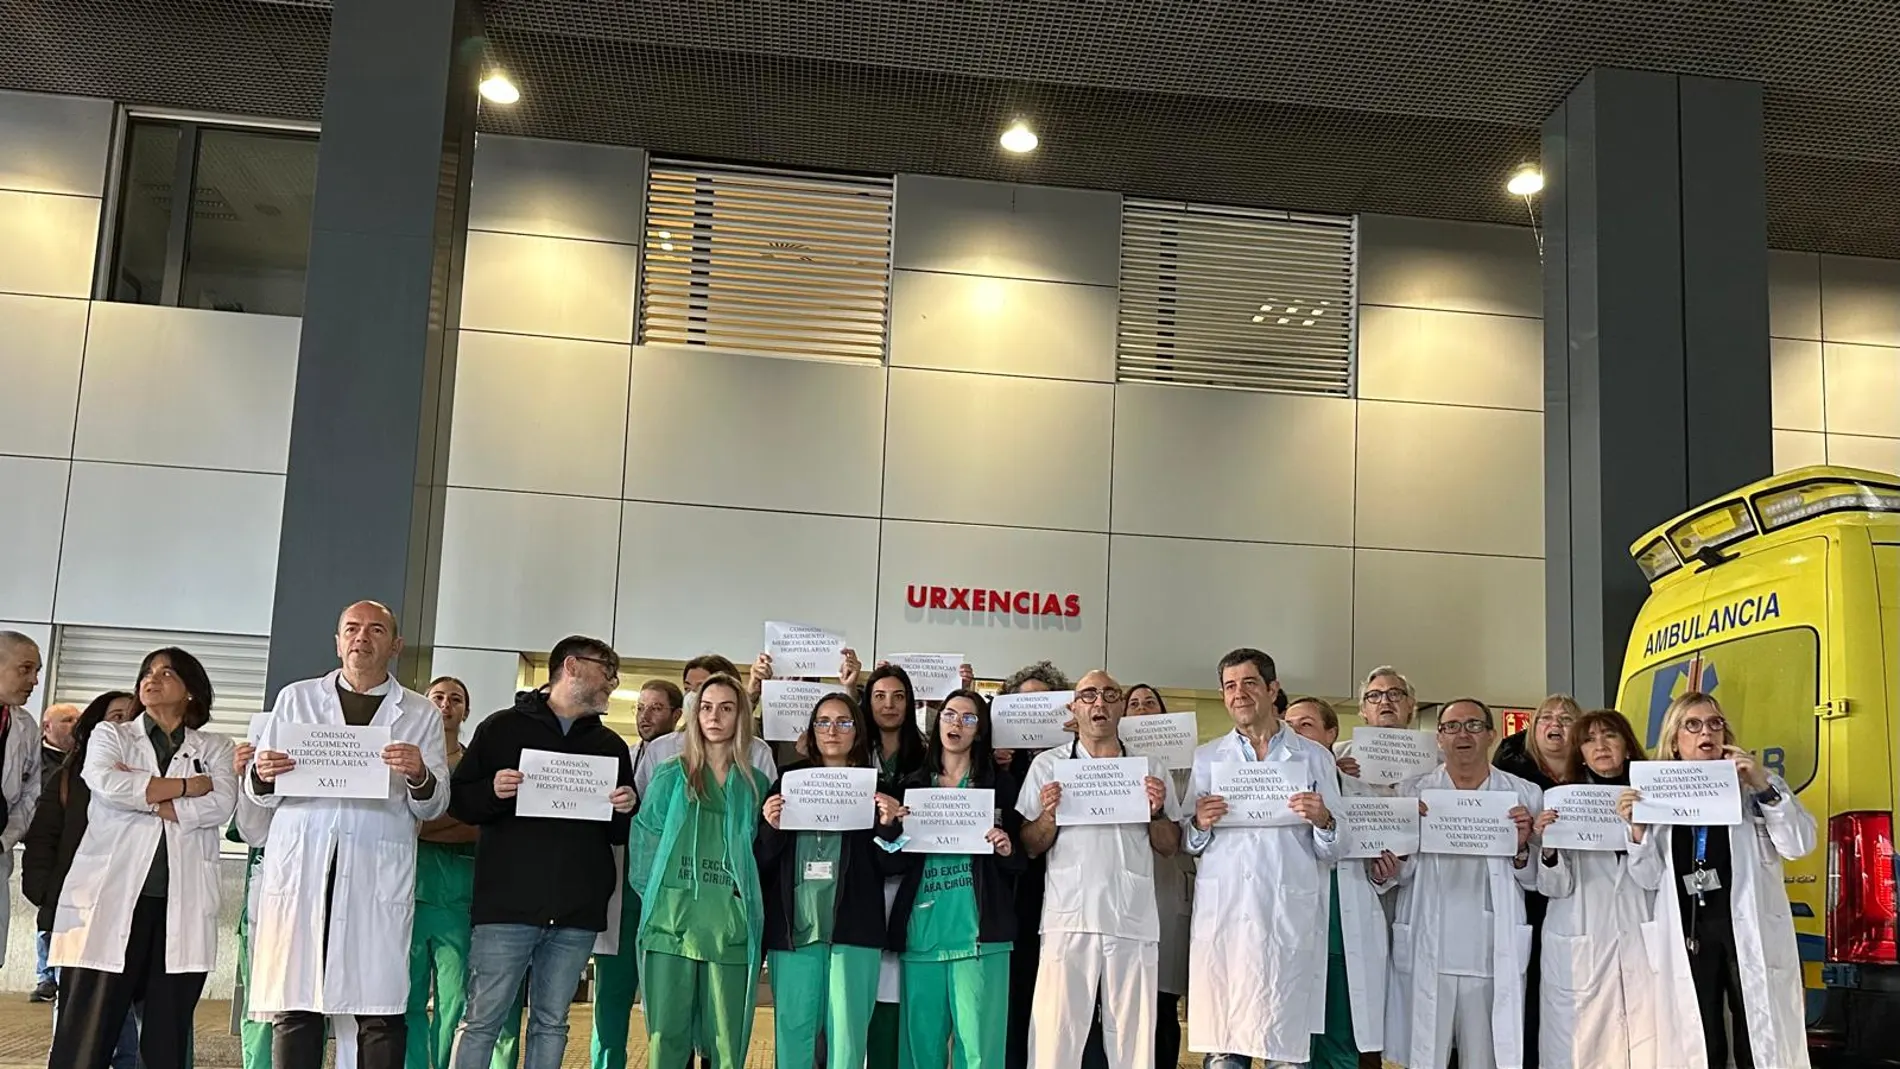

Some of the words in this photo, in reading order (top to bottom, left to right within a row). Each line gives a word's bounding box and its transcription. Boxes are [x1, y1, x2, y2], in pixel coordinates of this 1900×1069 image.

[907, 585, 1081, 617] URXENCIAS
[1644, 592, 1780, 658] AMBULANCIA
[302, 740, 361, 749] SEGUIMENTO
[286, 749, 328, 757] MEDICOS
[328, 749, 380, 758] URXENCIAS
[298, 757, 368, 767] HOSPITALARIAS
[541, 767, 593, 777] SEGUIMENTO
[1075, 772, 1124, 780] SEGUIMENTO
[317, 778, 348, 788] XA!!!
[527, 774, 563, 783] MEDICOS
[564, 777, 608, 786] URXENCIAS
[1062, 781, 1097, 789] MEDICOS
[1097, 779, 1141, 788] URXENCIAS
[1231, 776, 1282, 784] SEGUIMENTO
[536, 783, 597, 793] HOSPITALARIAS
[1254, 784, 1300, 792] URXENCIAS
[1639, 784, 1679, 792] MEDICOS
[1680, 782, 1729, 790] URXENCIAS
[789, 788, 825, 796] MEDICOS
[825, 789, 868, 797] URXENCIAS
[1072, 789, 1131, 797] HOSPITALARIAS
[1229, 793, 1288, 801] HOSPITALARIAS
[1652, 790, 1719, 798] HOSPITALARIAS
[551, 800, 577, 810] XA!!!
[798, 797, 858, 805] HOSPITALARIAS
[1563, 799, 1616, 807] SEGUIMENTO
[1090, 807, 1115, 816] XA!!!
[1247, 810, 1273, 819] XA!!!
[1672, 808, 1700, 817] XA!!!
[815, 814, 840, 823] XA!!!
[936, 836, 960, 845] XA!!!
[1576, 832, 1603, 841] XA!!!
[1360, 841, 1385, 850] XA!!!
